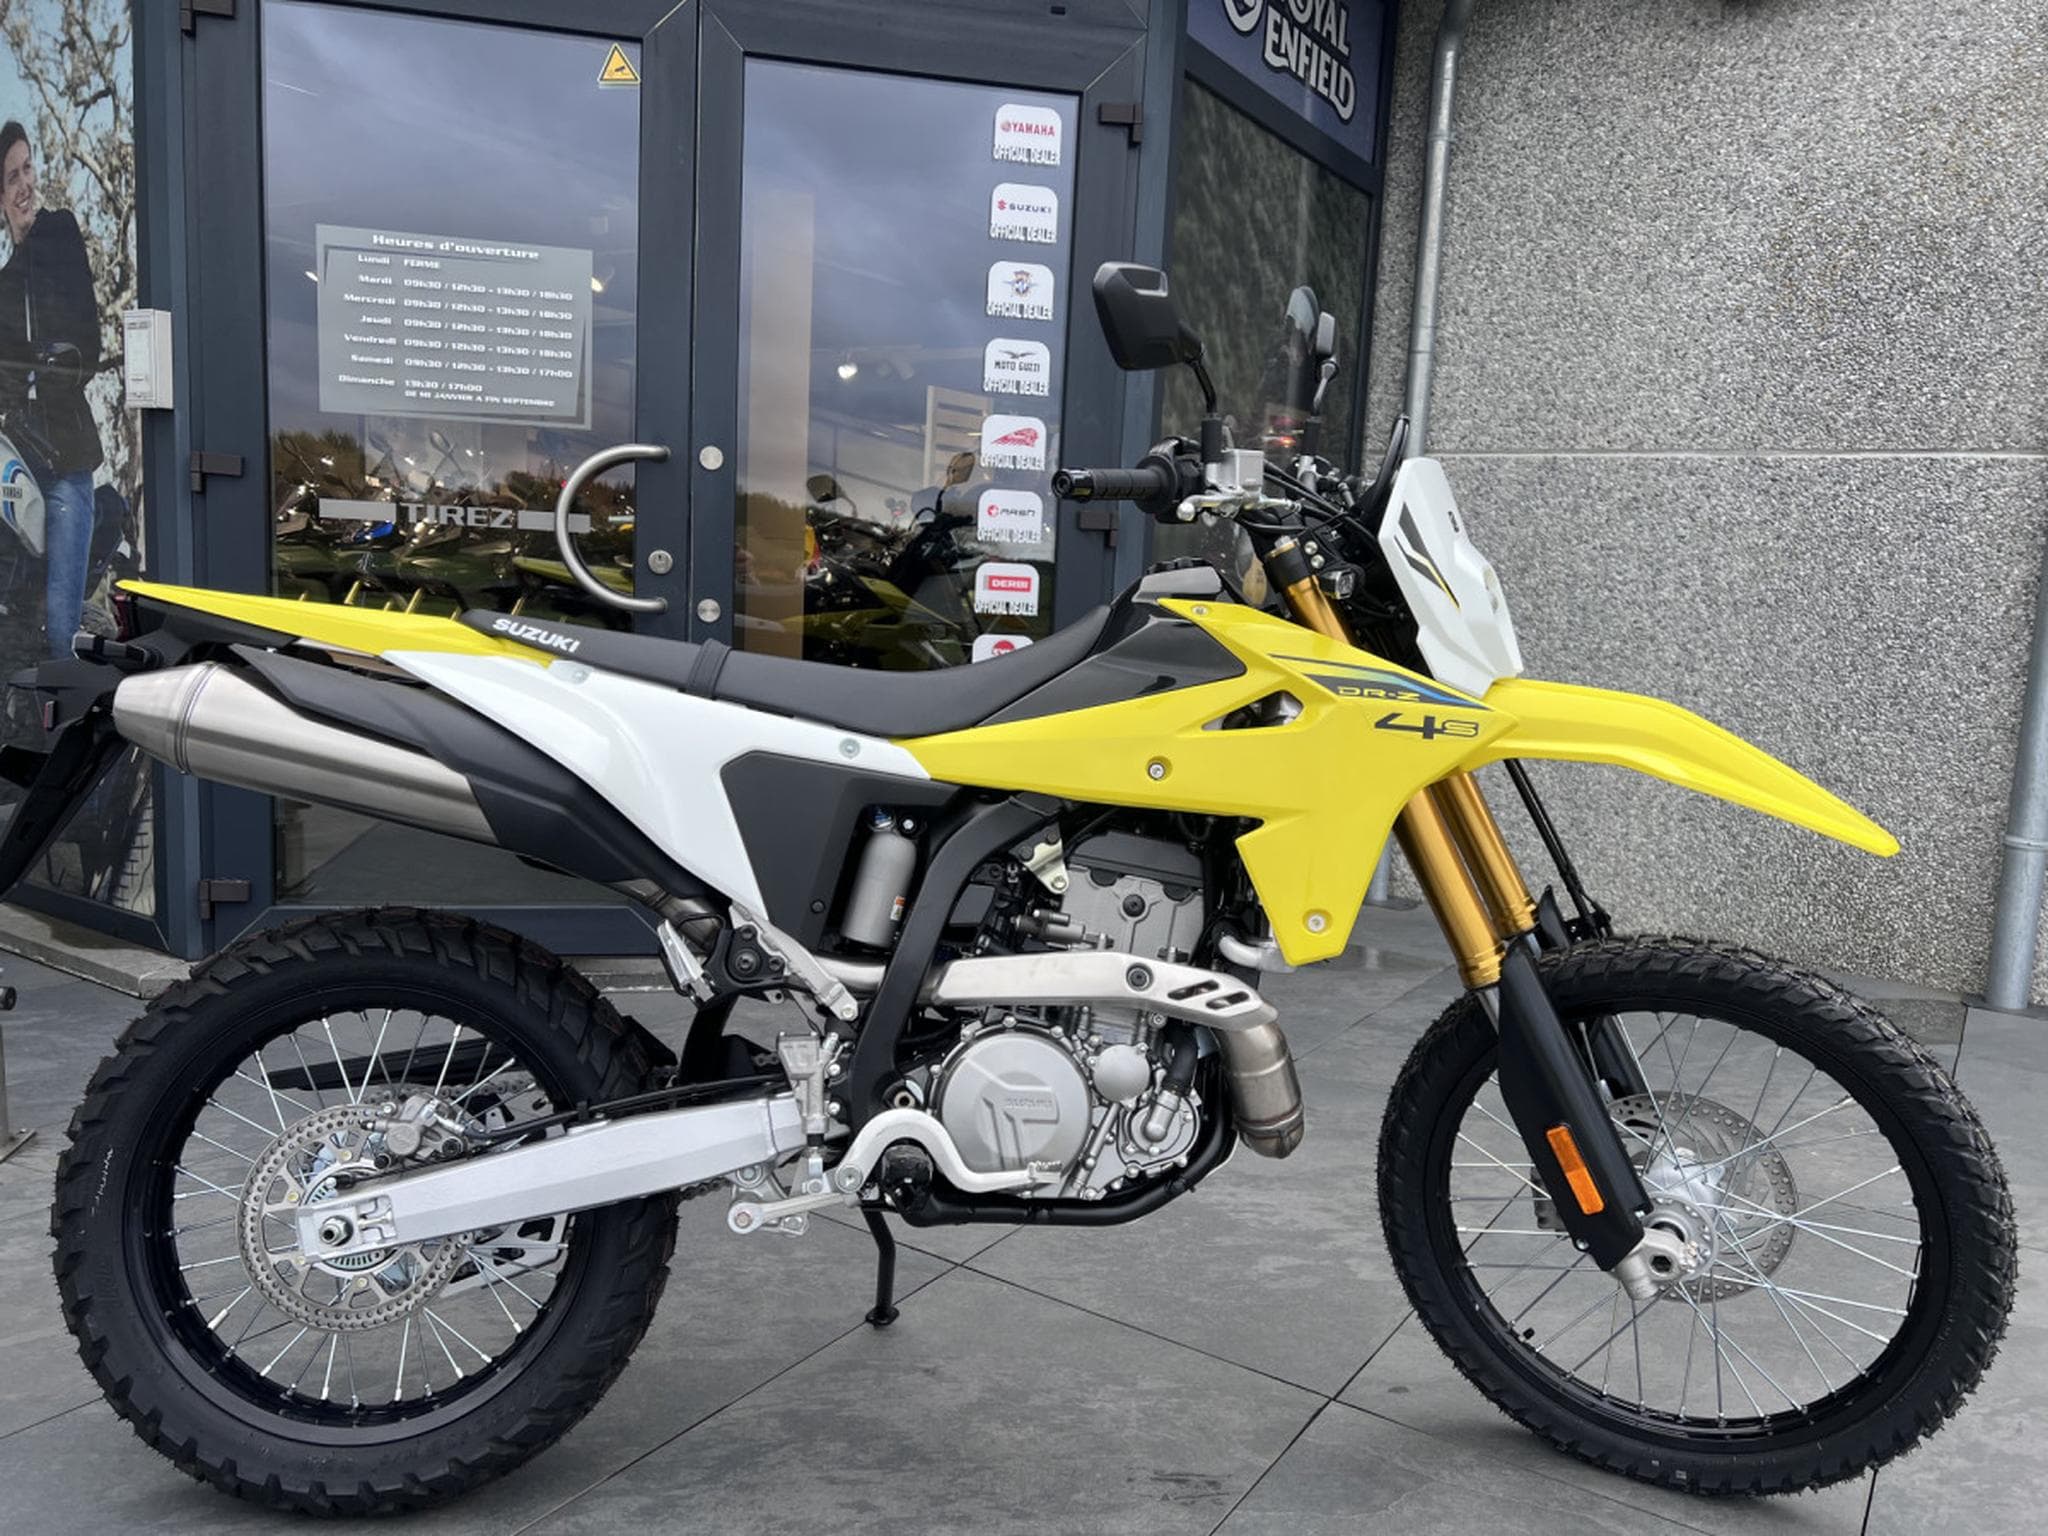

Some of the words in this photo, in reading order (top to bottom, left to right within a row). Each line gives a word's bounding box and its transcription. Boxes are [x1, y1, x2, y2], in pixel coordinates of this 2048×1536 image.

[1264, 5, 1355, 120] ENFIELD
[1010, 122, 1056, 136] YAMAHA
[1008, 203, 1052, 214] SUZUKI
[373, 235, 434, 249] Heures
[439, 241, 539, 259] d'ouverture
[358, 254, 390, 265] Lundi
[359, 275, 392, 285] Mardi
[344, 293, 396, 305] Mercredi
[986, 301, 1022, 319] OFFICIAL
[361, 315, 392, 325] Jeudi
[344, 333, 397, 345] Vendredi
[351, 354, 394, 365] Samedi
[994, 361, 1016, 372] MOTO
[1018, 361, 1041, 373] GUZZI
[338, 374, 395, 386] Dimanche
[502, 397, 555, 407] SEPTEMBRE
[400, 502, 513, 529] TIREZ
[492, 618, 581, 653] SUZUKI
[1374, 712, 1480, 740] 4S
